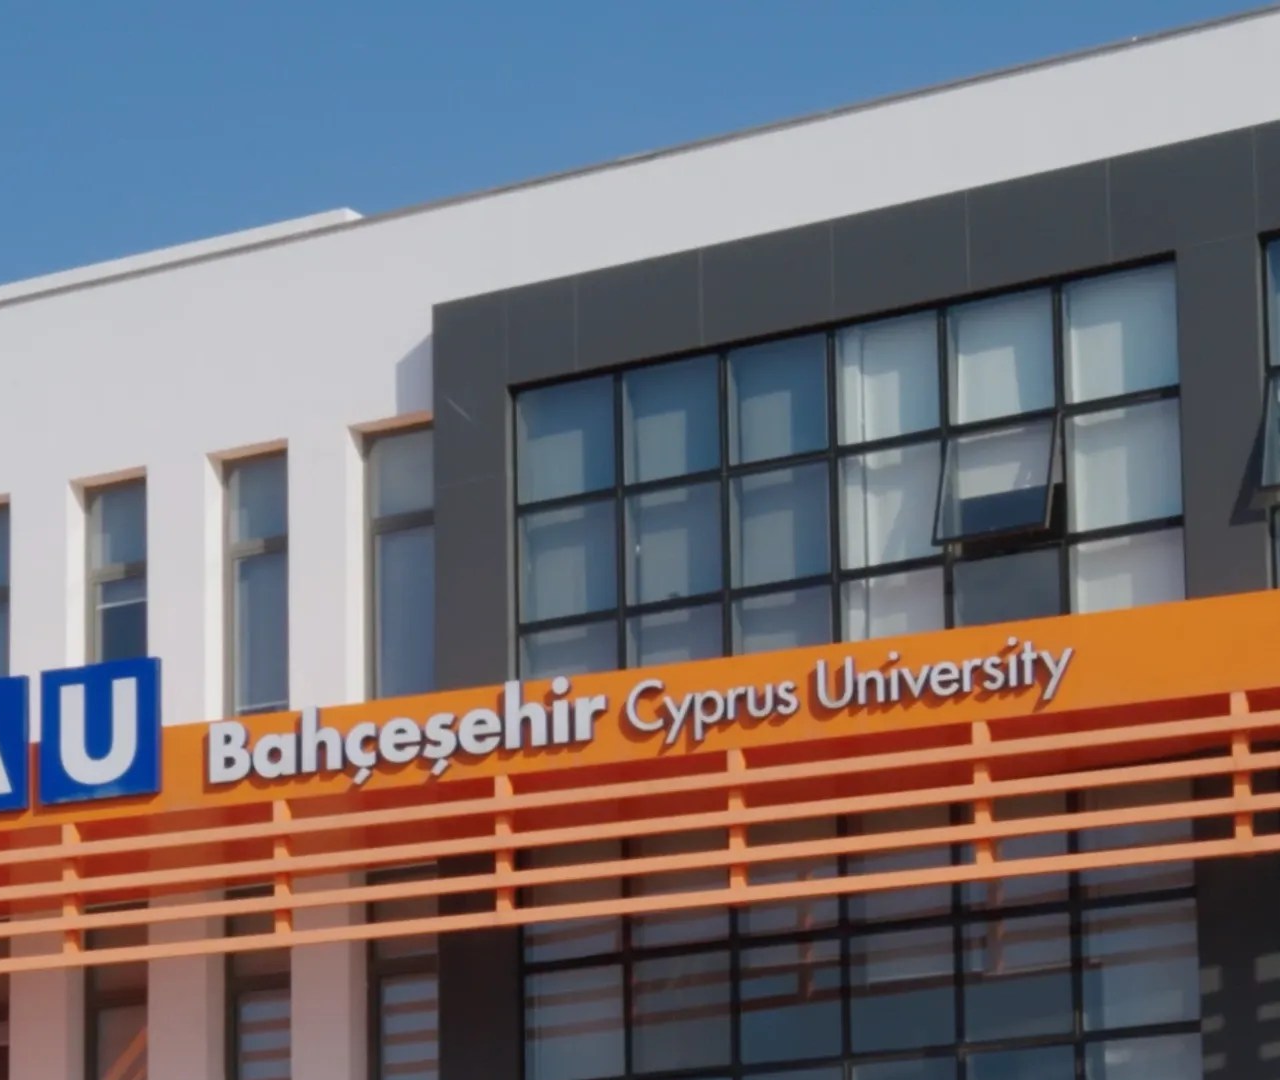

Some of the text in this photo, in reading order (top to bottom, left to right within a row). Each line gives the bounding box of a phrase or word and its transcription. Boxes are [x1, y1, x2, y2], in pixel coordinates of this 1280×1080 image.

[208, 636, 1074, 785] Bahçeşehir Cyprus University
